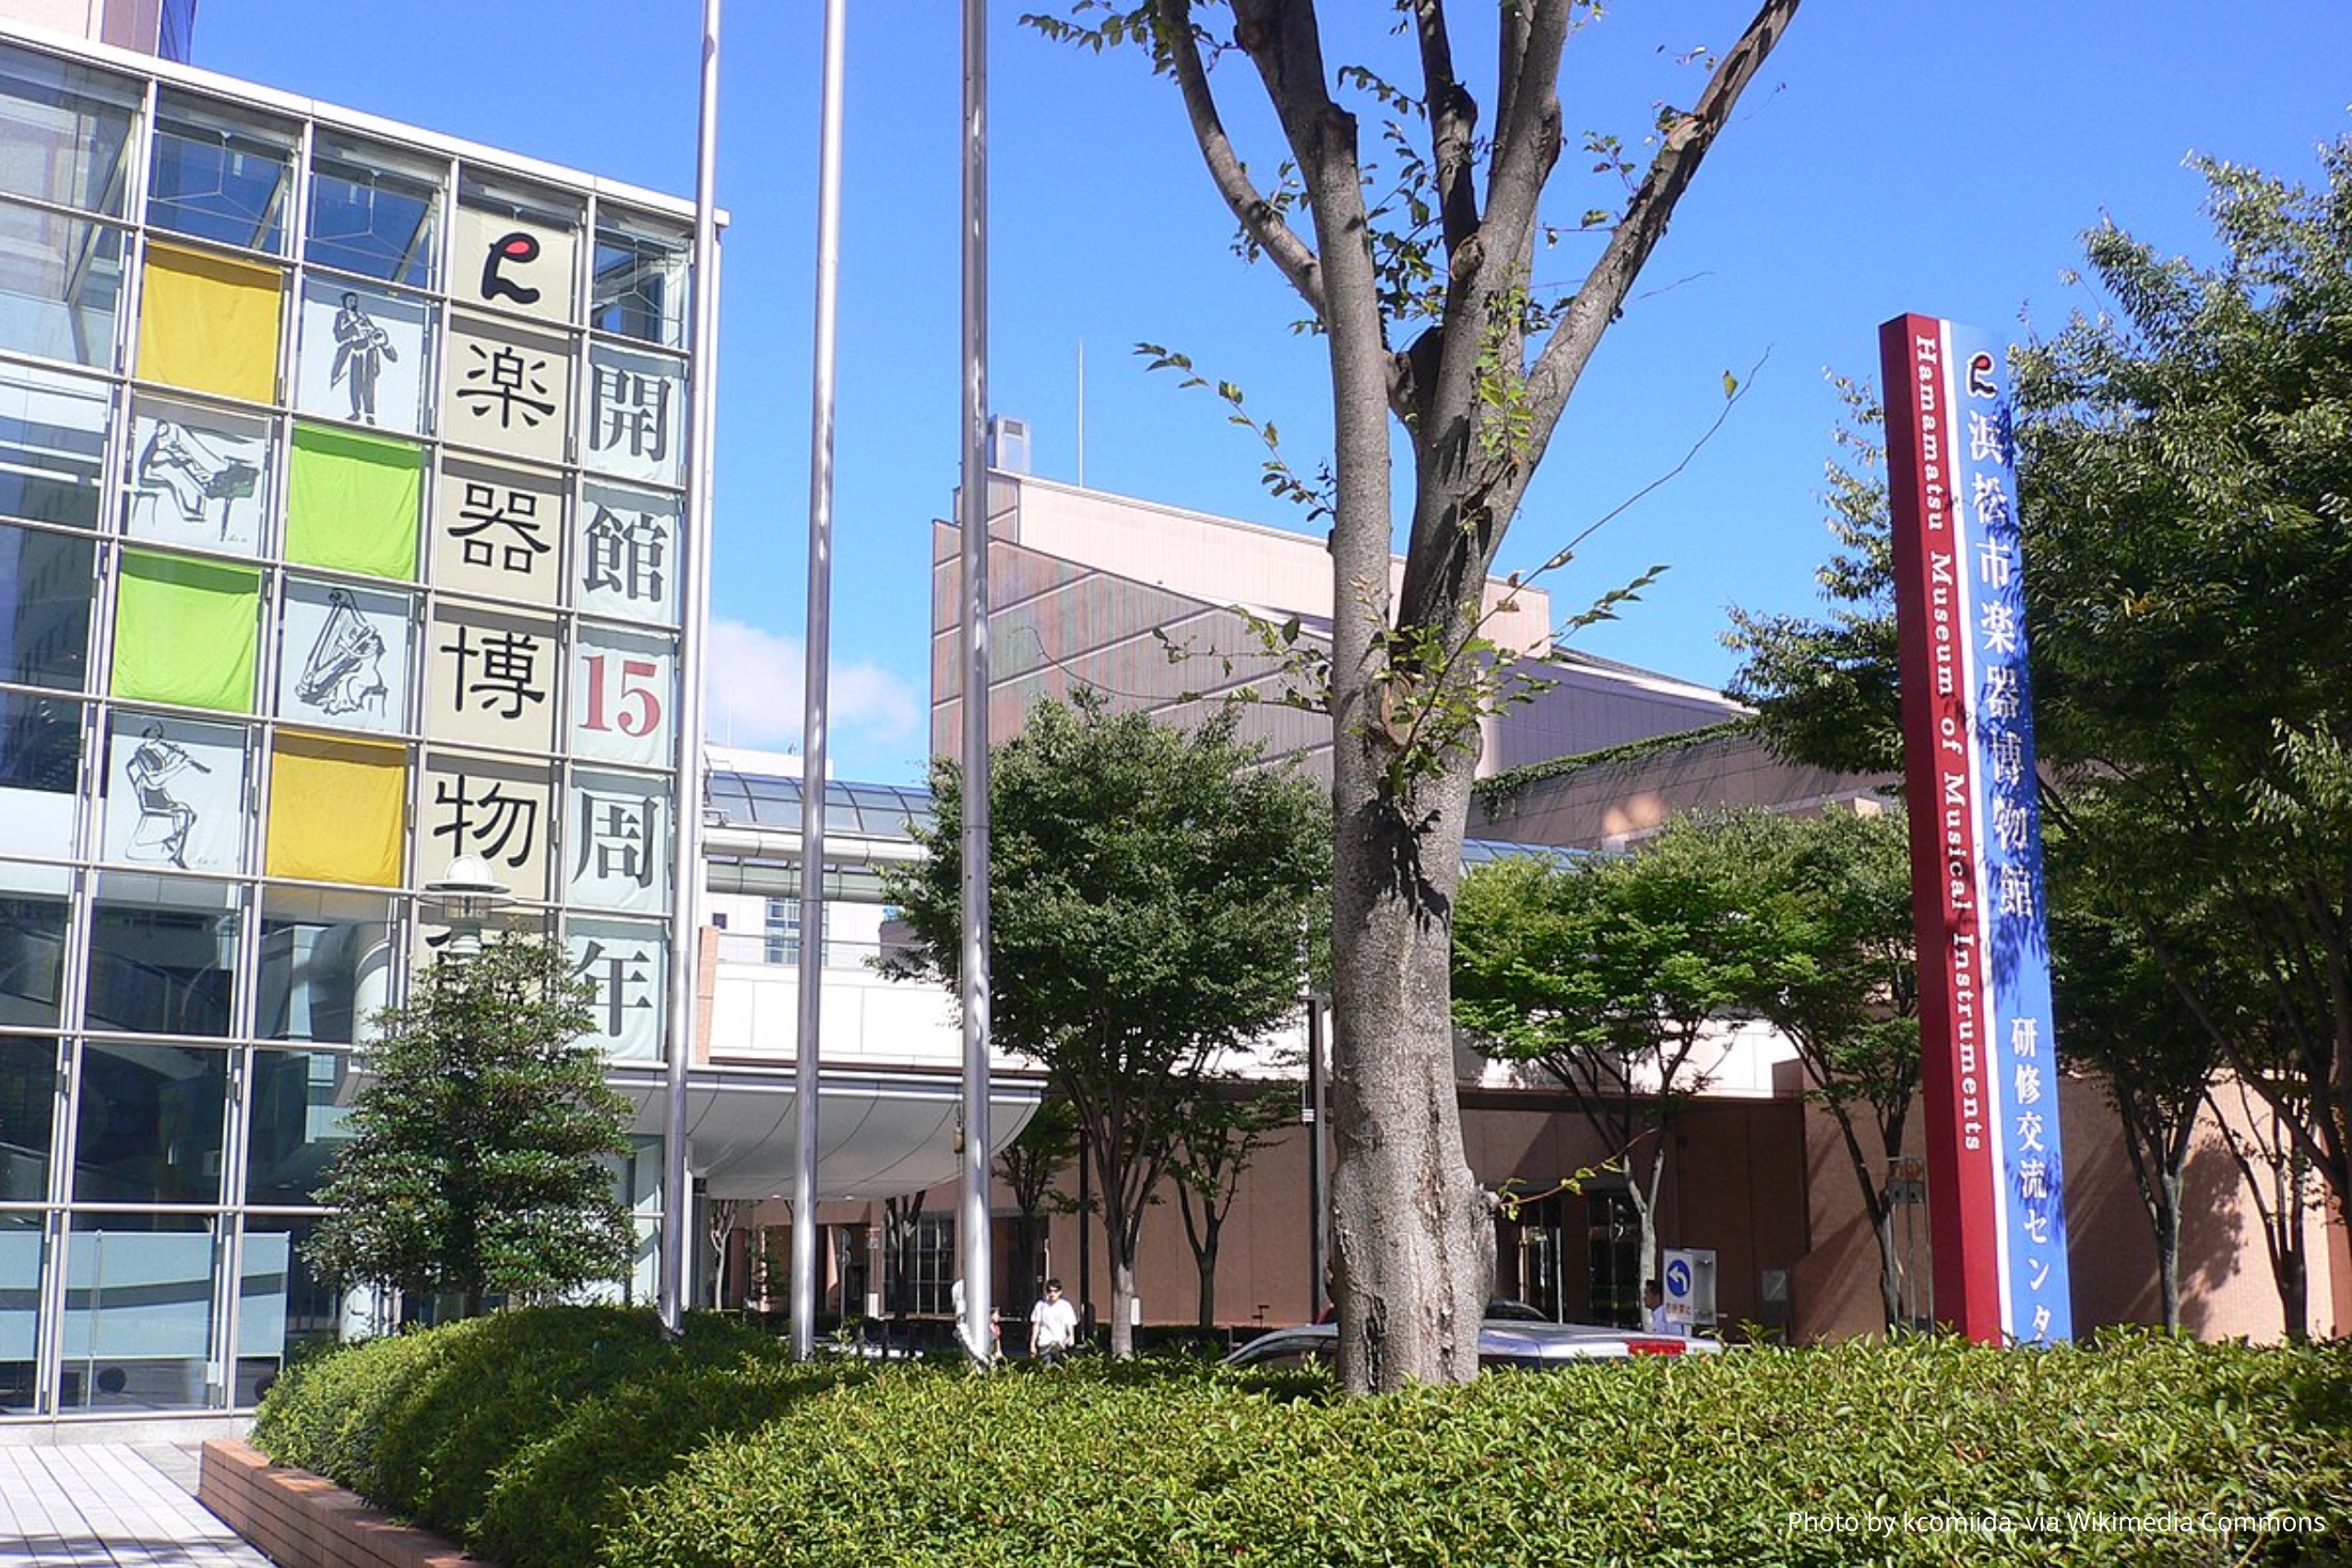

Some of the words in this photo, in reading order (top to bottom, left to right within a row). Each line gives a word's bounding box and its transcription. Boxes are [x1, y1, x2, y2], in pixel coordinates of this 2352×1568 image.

[1916, 334, 1943, 530] Hamamatsu
[424, 345, 556, 1005] 楽器博物
[569, 363, 671, 1037] 開館15周年
[1930, 551, 1954, 695] Museum
[1967, 410, 2033, 918] 浜松市楽器博物館
[1941, 717, 1963, 755] of
[1943, 771, 1974, 911] Musical
[1953, 932, 1981, 1151] Instruments
